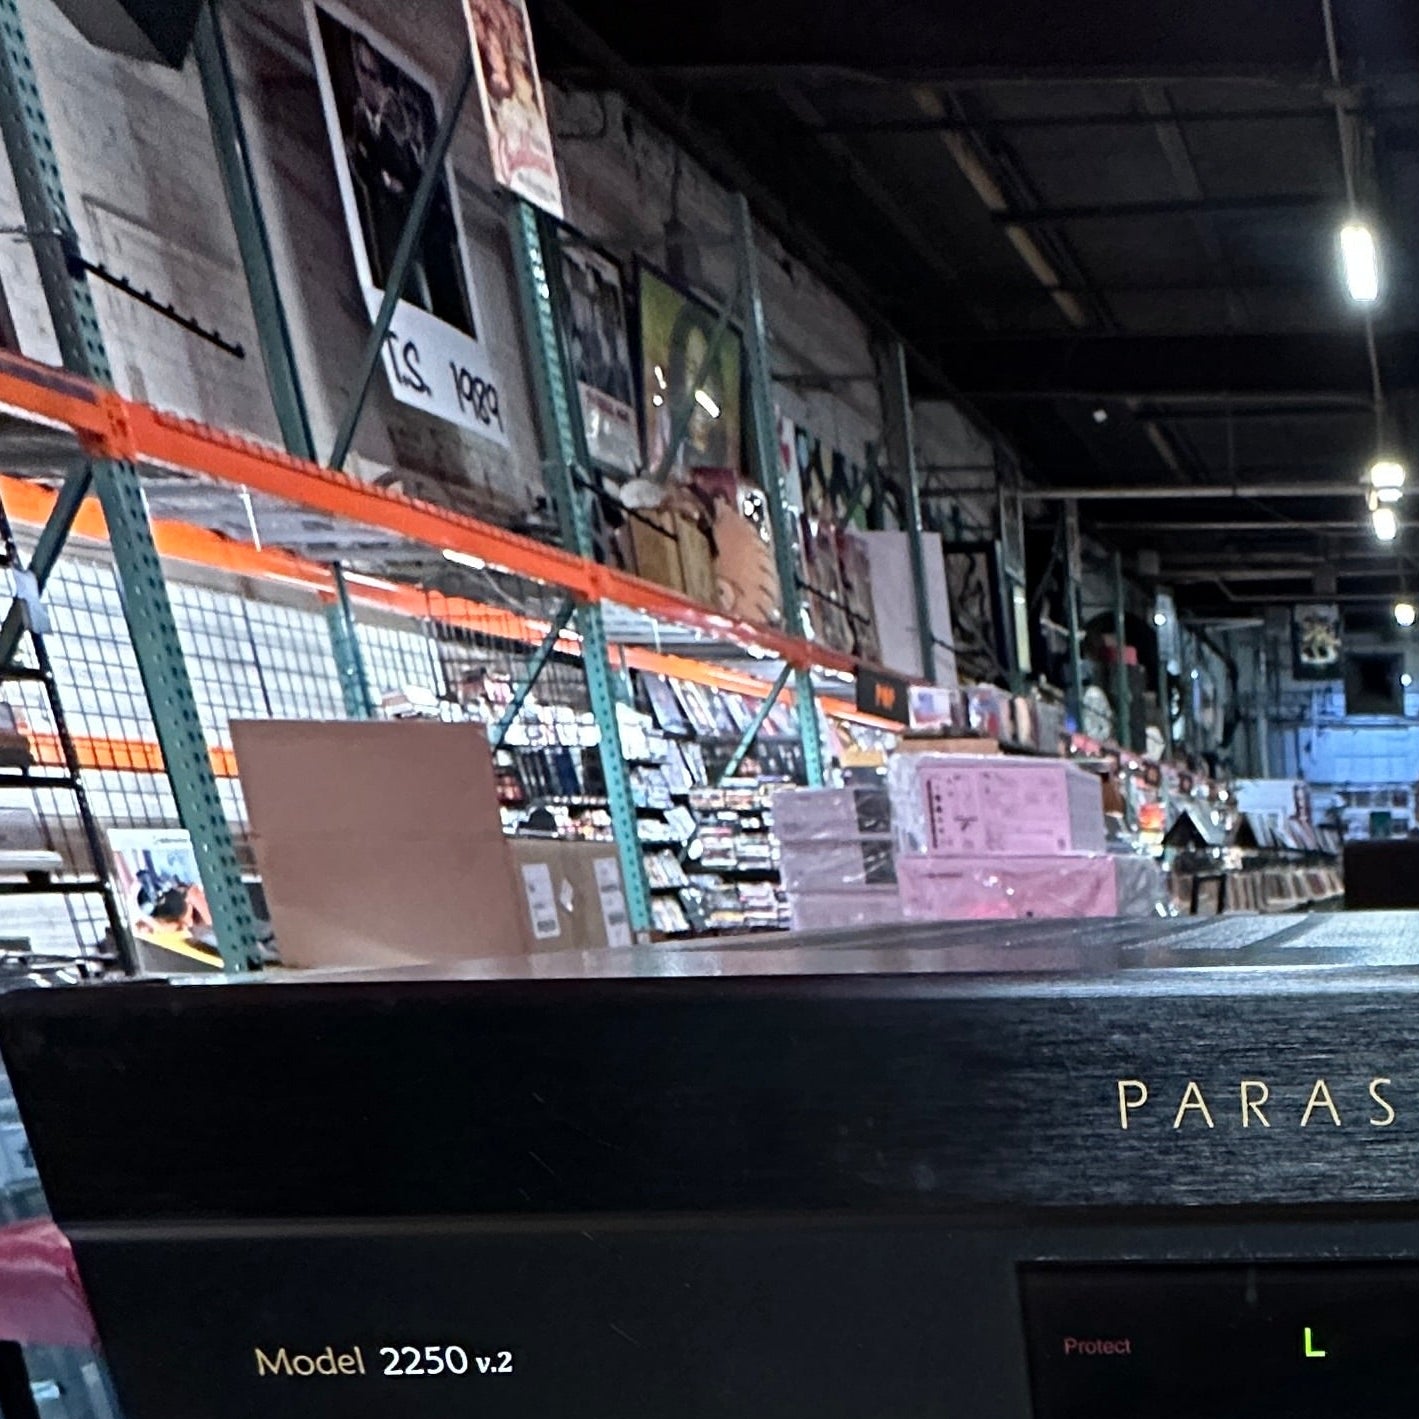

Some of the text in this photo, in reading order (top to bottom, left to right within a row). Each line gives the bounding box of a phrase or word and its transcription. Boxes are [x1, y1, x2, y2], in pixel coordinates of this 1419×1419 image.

[449, 361, 504, 432] 1989
[1063, 1337, 1131, 1355] Protect
[1304, 1327, 1326, 1358] L
[254, 1345, 513, 1376] Model 2250 v.2
